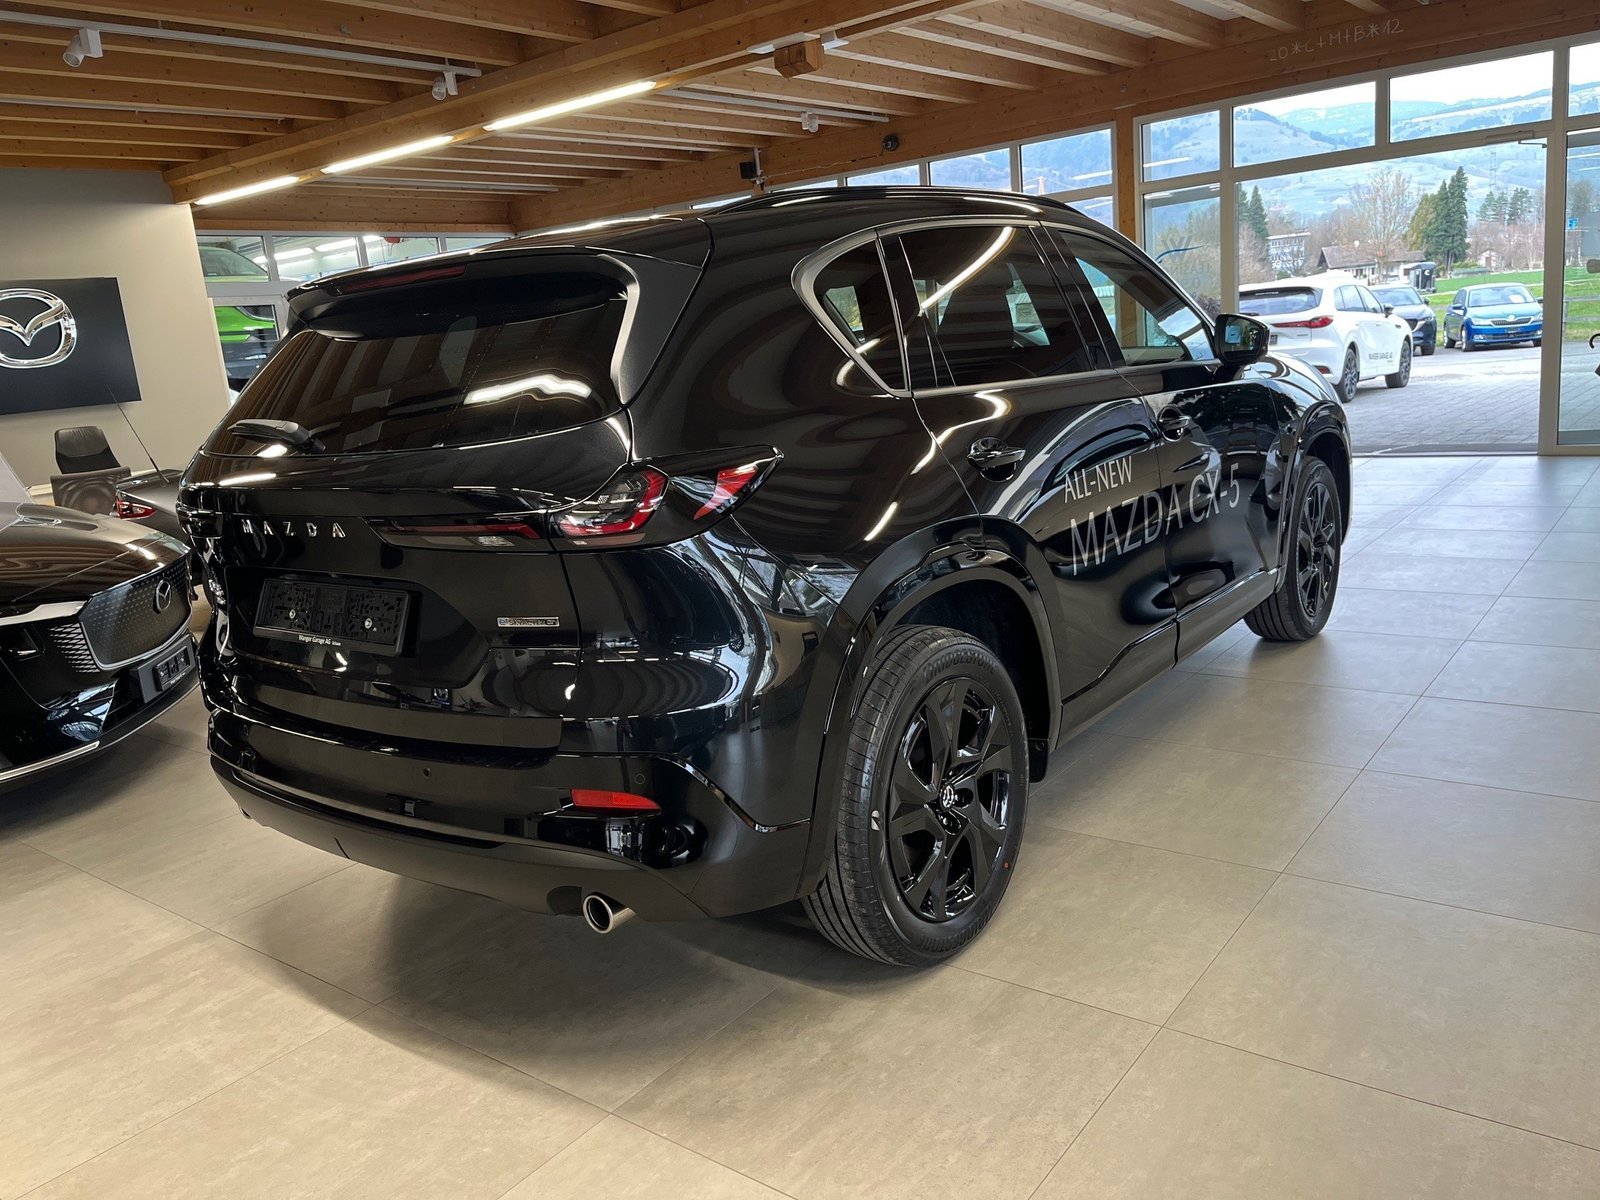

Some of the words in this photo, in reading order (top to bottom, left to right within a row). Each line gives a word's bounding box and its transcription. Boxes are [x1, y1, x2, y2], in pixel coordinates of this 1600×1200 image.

[1064, 456, 1132, 503] ALL-NEW
[241, 519, 346, 538] MAZDA
[1070, 484, 1183, 576] MAZDA
[1189, 463, 1240, 523] CX-5
